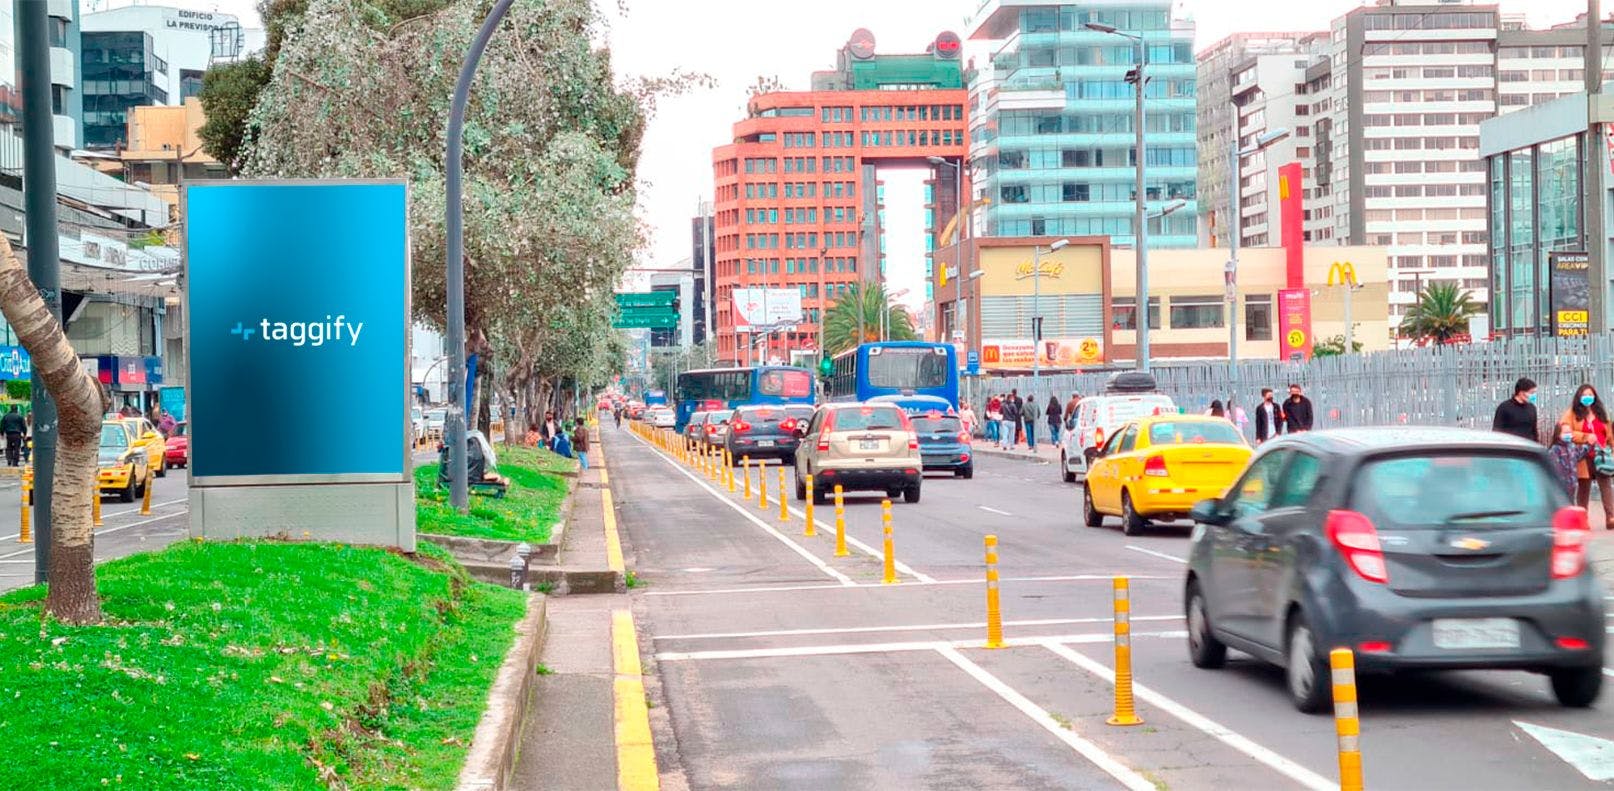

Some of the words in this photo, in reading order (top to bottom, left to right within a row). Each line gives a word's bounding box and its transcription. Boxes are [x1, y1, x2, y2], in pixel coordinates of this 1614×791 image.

[178, 10, 213, 20] EDIFICIO
[166, 20, 177, 28] LA
[1563, 312, 1583, 321] CCI
[260, 315, 363, 346] taggify
